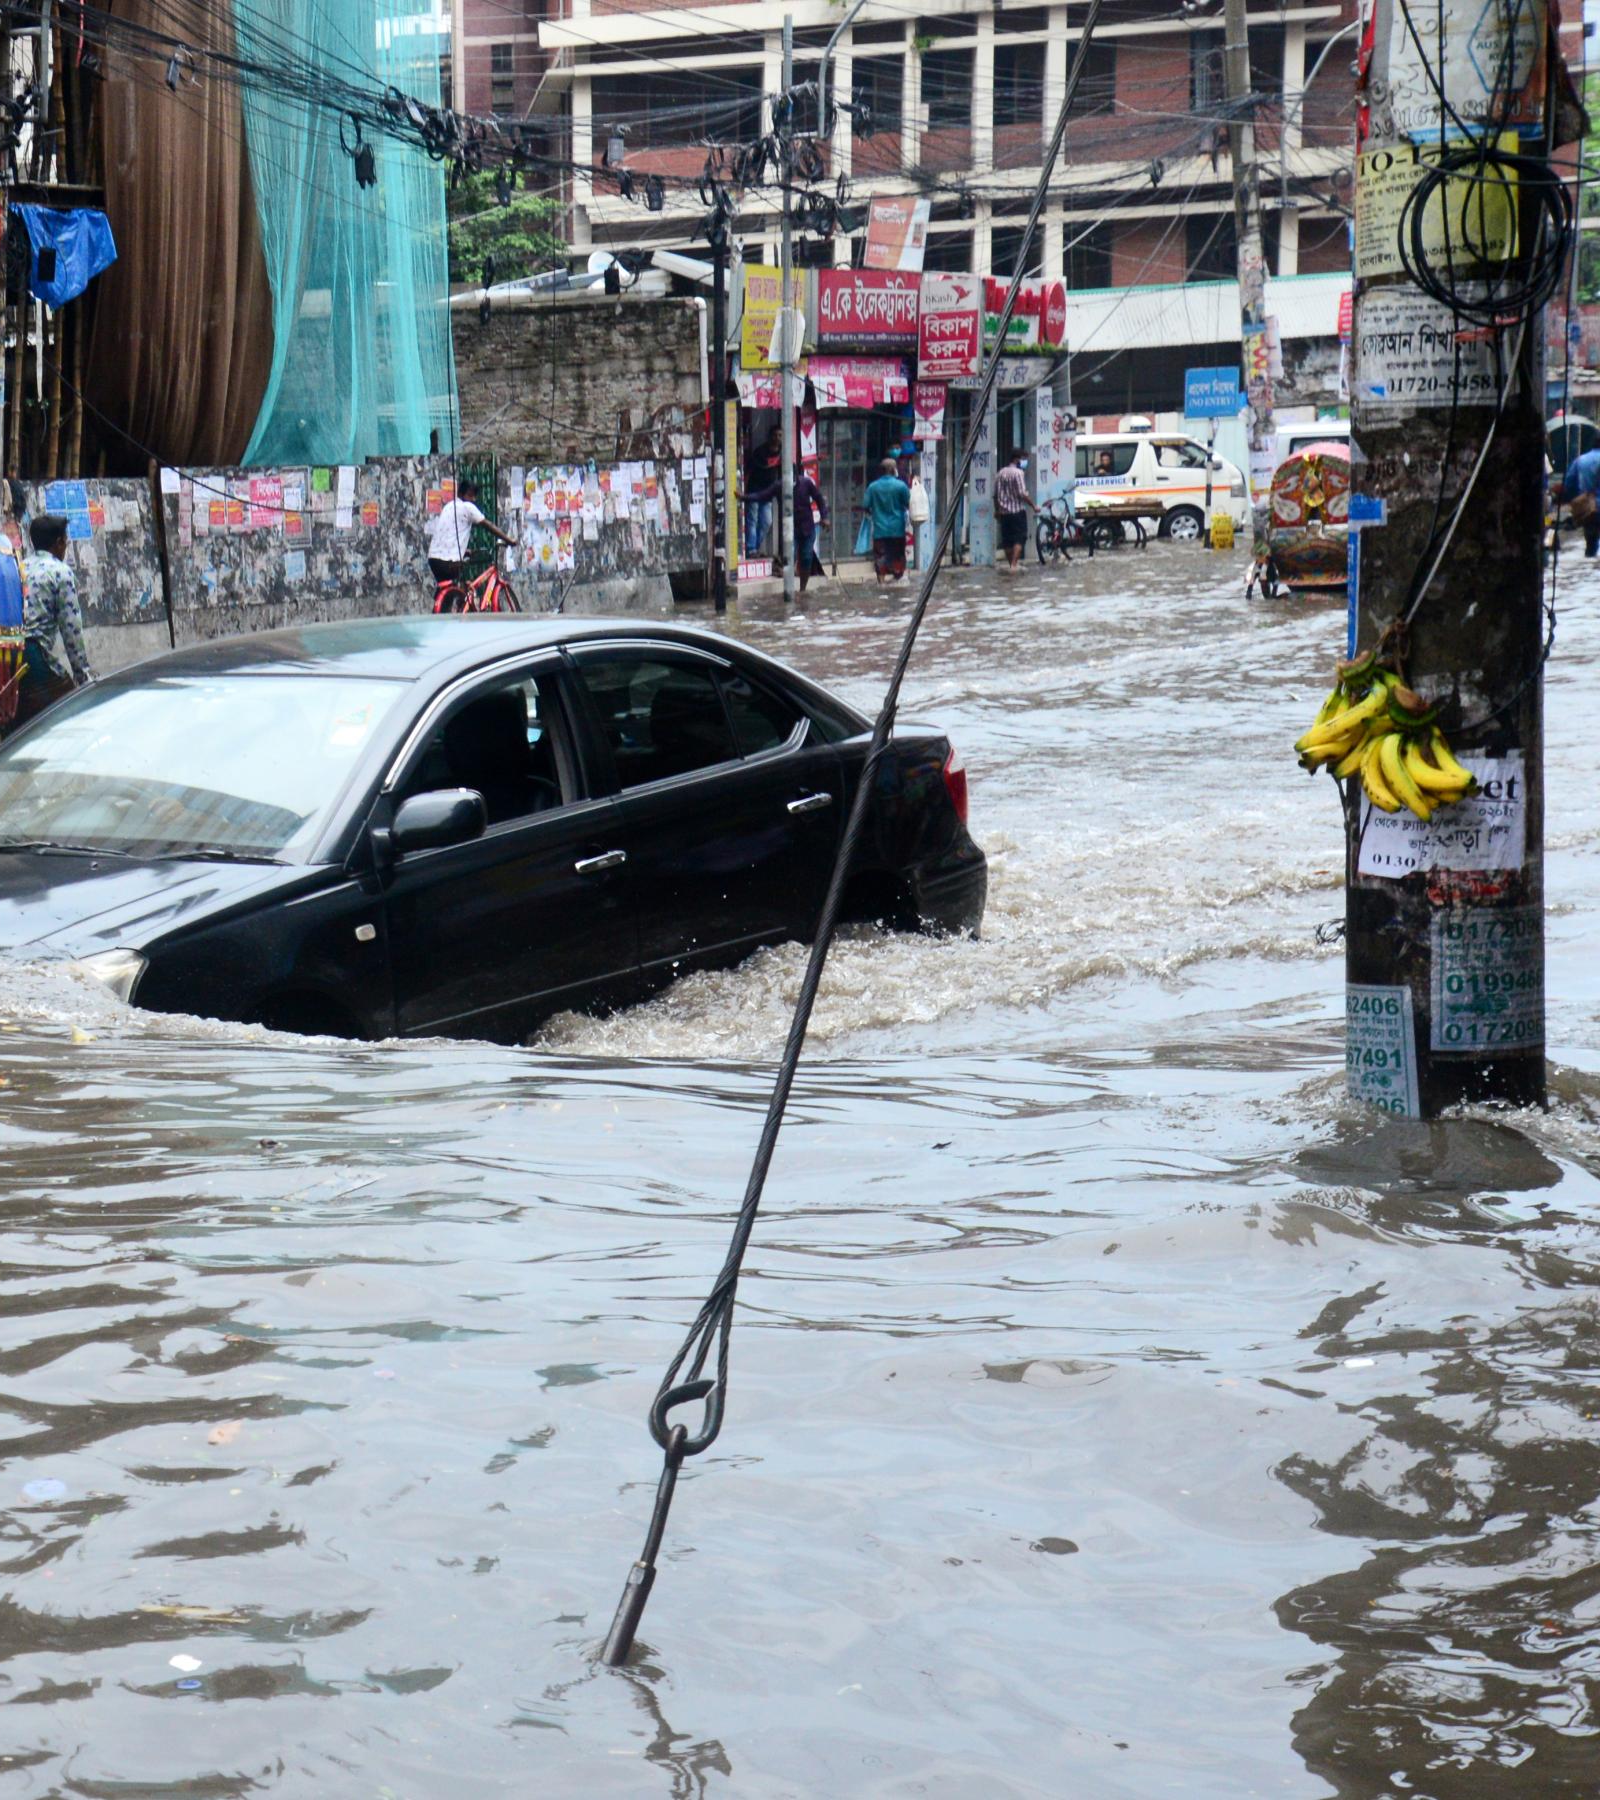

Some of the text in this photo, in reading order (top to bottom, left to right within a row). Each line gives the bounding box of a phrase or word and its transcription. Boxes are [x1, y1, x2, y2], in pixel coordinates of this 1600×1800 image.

[923, 315, 975, 338] বিকাশ
[925, 338, 971, 359] করুন
[1096, 477, 1127, 486] SERVICE
